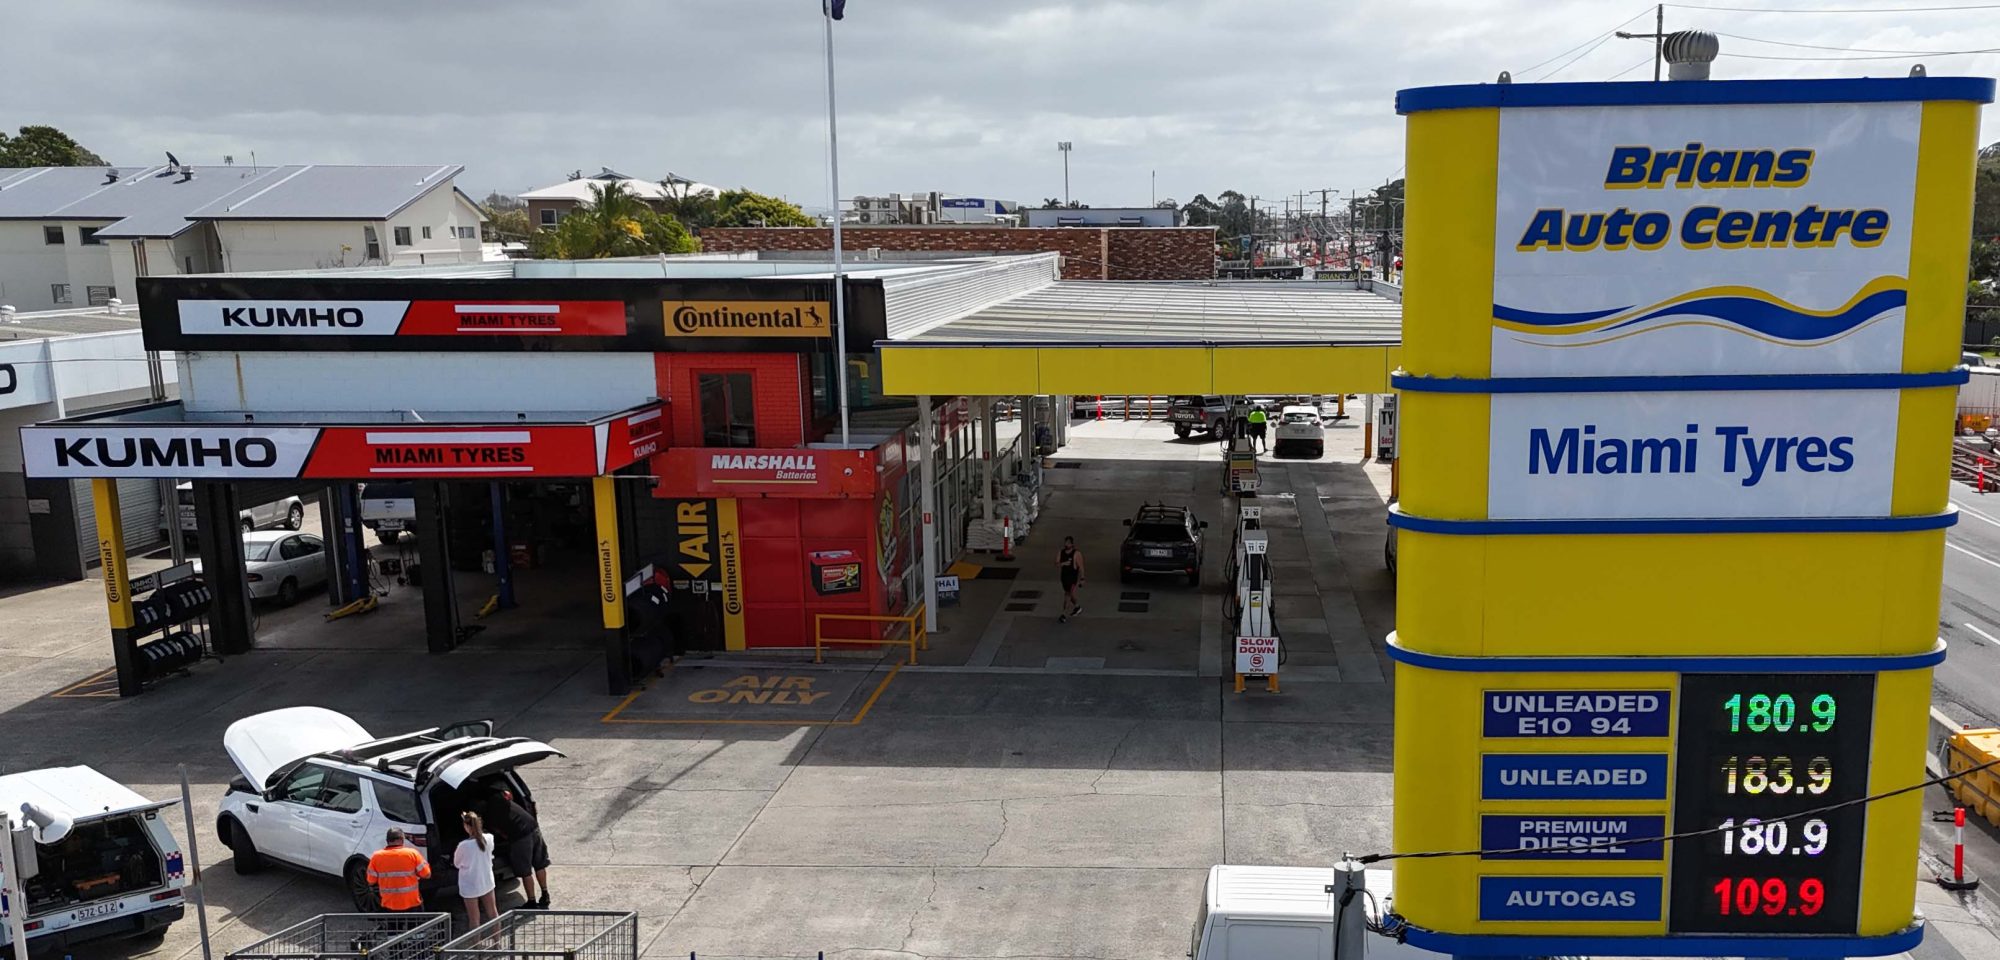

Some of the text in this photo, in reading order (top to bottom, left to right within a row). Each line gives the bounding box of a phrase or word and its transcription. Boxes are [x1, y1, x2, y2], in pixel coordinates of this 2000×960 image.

[1604, 143, 1816, 190] Brians
[1516, 204, 1892, 252] Auto Centre
[222, 307, 364, 327] KUMHO
[460, 314, 557, 326] MIAMI TYRES
[673, 305, 803, 333] Continental
[54, 437, 277, 468] KUMHO
[375, 447, 525, 464] MIAMI TYRES
[633, 442, 657, 459] KUMHO
[1528, 423, 1855, 487] Miami Tyres
[711, 454, 816, 470] MARSHALL
[775, 470, 817, 480] Batteries
[677, 502, 711, 561] AIR
[102, 548, 121, 603] Continental
[601, 547, 616, 603] Continental
[724, 543, 742, 615] Continental
[1239, 646, 1276, 654] DOWN
[1240, 638, 1275, 646] SLOW
[1252, 656, 1262, 665] 5
[722, 675, 817, 689] AIR
[687, 689, 833, 705] ONLY
[1492, 694, 1659, 713] UNLEADED
[1724, 694, 1836, 733] 180.9
[1518, 717, 1632, 735] E10 94
[1500, 768, 1648, 786] UNLEADED
[1720, 756, 1833, 795] 183.9
[1519, 820, 1627, 834] PREMIUM
[1717, 817, 1828, 855] 180.9
[1519, 836, 1626, 854] DIESEL
[1506, 890, 1636, 907] AUTOGAS
[1713, 877, 1825, 916] 109.9
